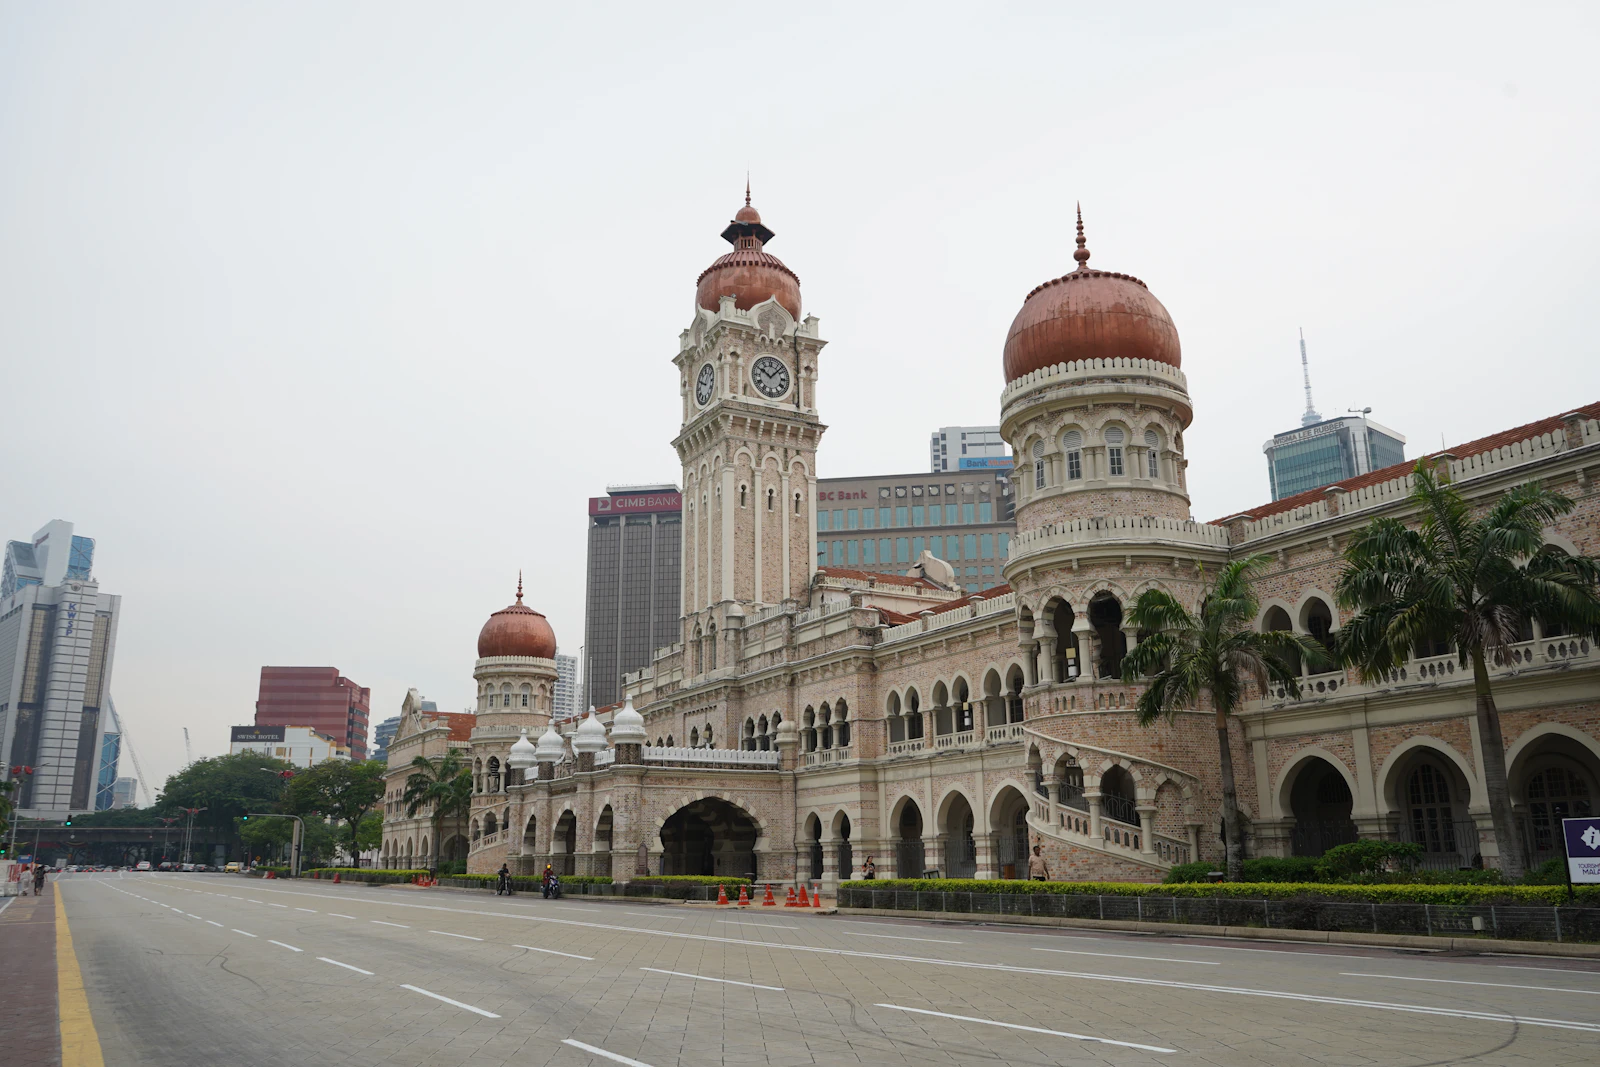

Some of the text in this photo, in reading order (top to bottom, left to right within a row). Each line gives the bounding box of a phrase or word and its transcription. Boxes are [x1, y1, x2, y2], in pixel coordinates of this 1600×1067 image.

[1273, 421, 1344, 445] WISMA LEE RUBBER
[966, 459, 988, 468] Bank
[816, 490, 867, 501] BC Bank
[616, 496, 678, 508] CIMB BANK
[65, 602, 77, 636] KWSP
